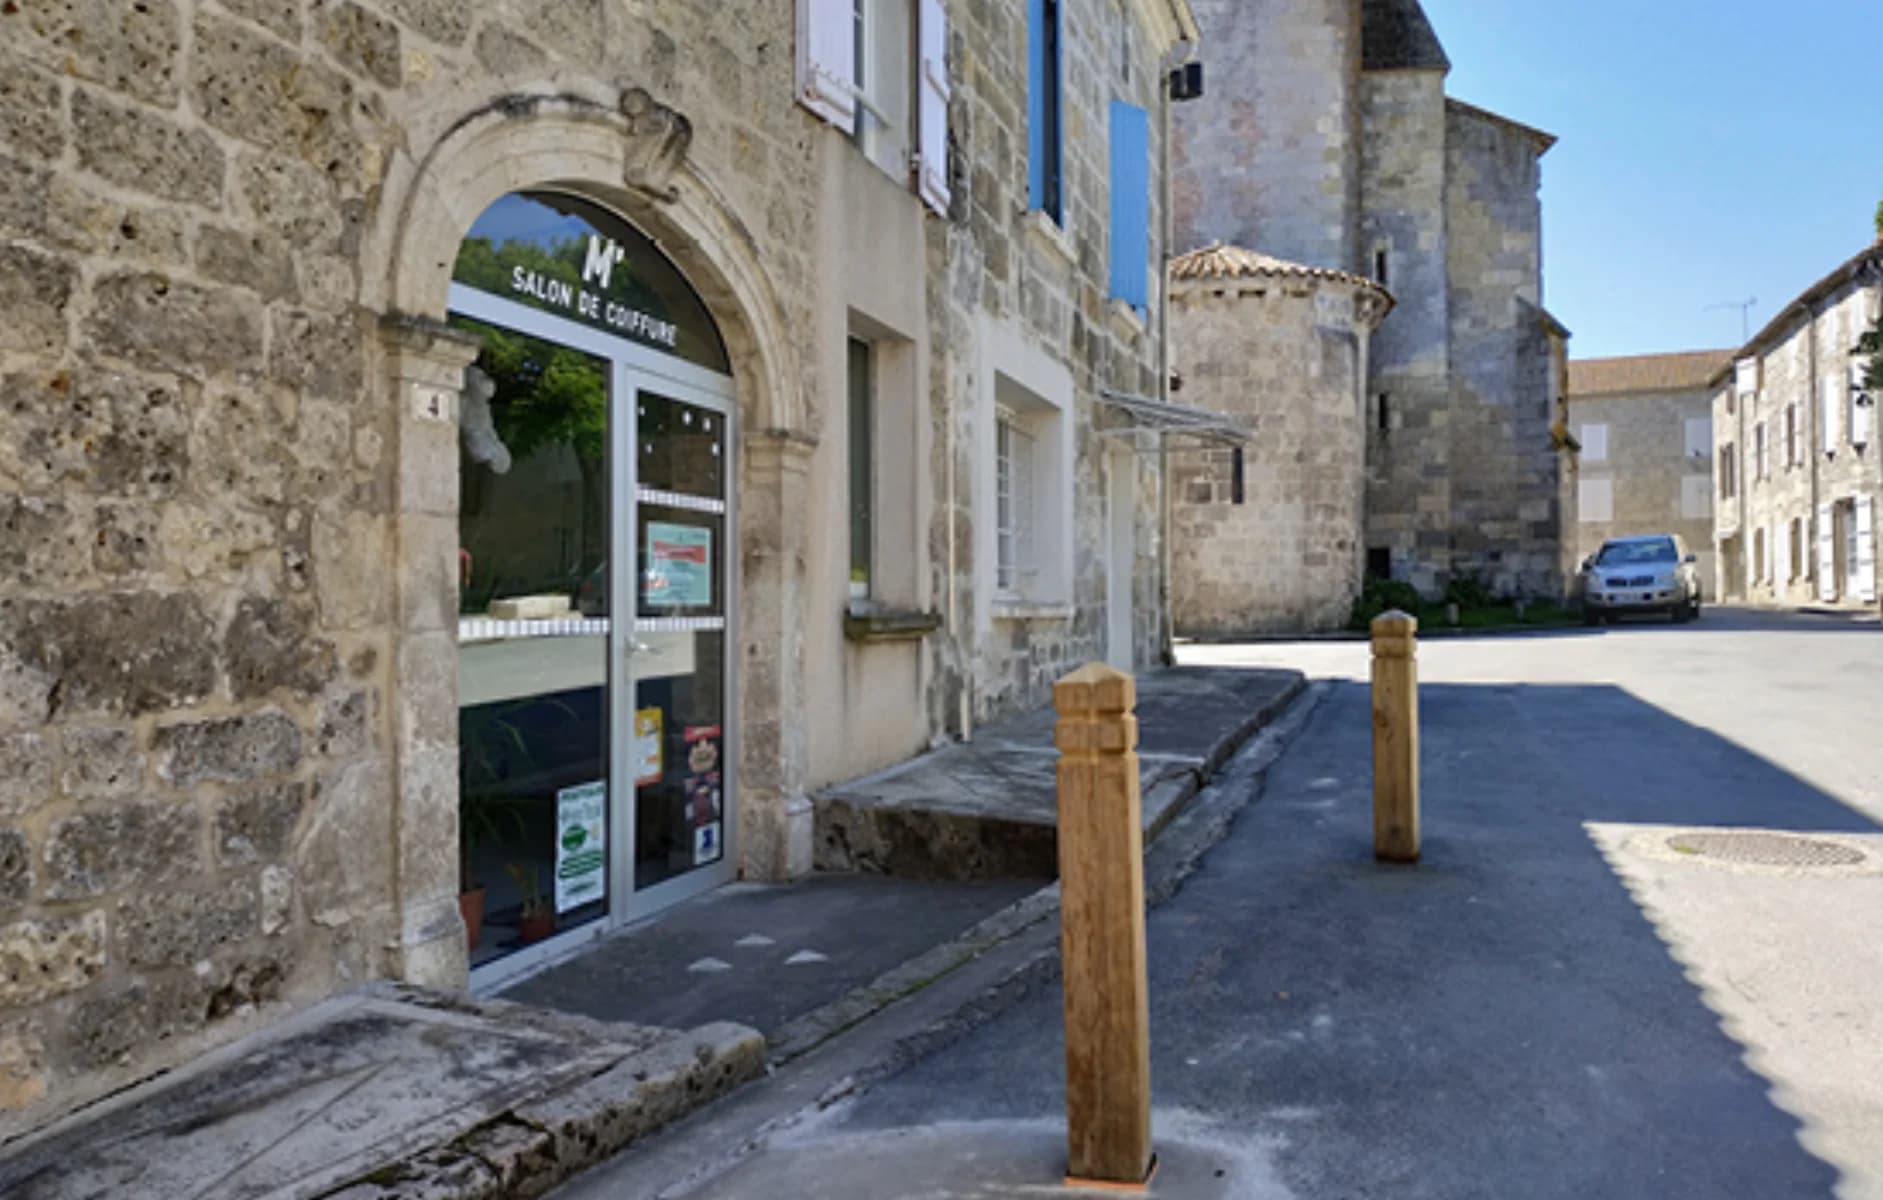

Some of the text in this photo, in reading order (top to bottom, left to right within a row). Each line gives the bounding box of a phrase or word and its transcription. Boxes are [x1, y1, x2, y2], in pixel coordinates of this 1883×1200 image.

[511, 265, 678, 347] SALON DE COIFFURE
